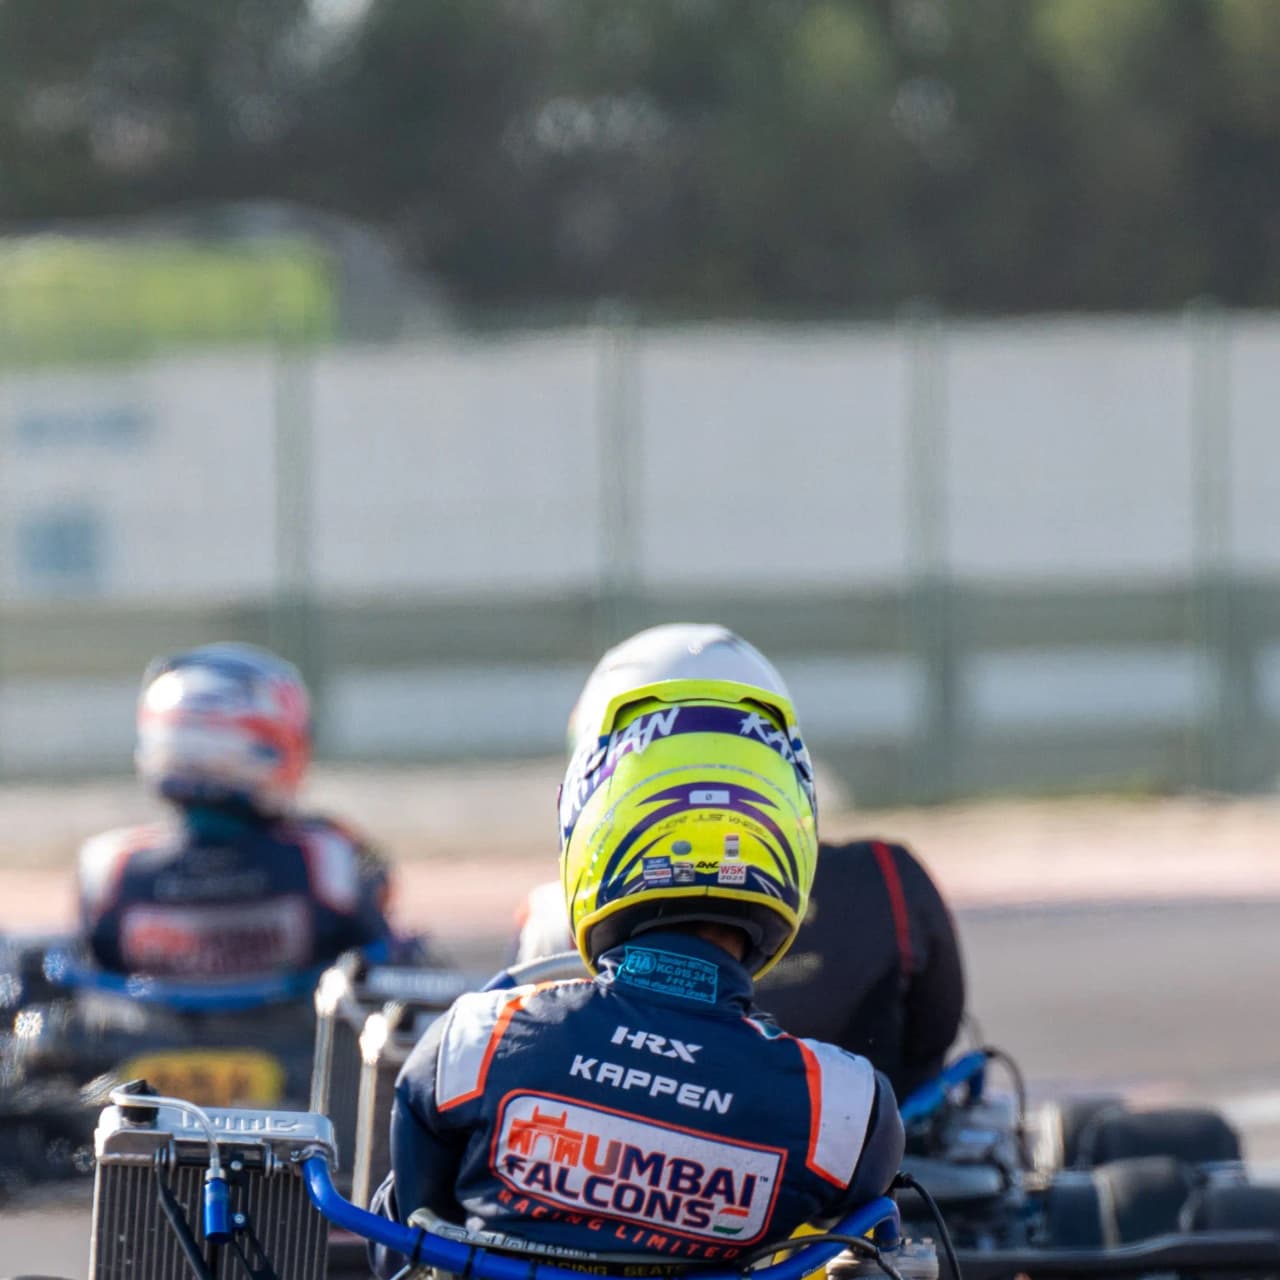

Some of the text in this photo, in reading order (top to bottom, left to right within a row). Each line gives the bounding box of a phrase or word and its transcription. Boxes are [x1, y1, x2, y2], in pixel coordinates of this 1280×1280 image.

[720, 865, 744, 874] WSK
[627, 953, 651, 970] FIA
[611, 1026, 703, 1064] HRX
[569, 1055, 733, 1114] KAPPEN
[501, 1153, 715, 1229] FALCONS
[499, 1189, 604, 1231] RACING
[615, 1225, 740, 1259] LIMITED
